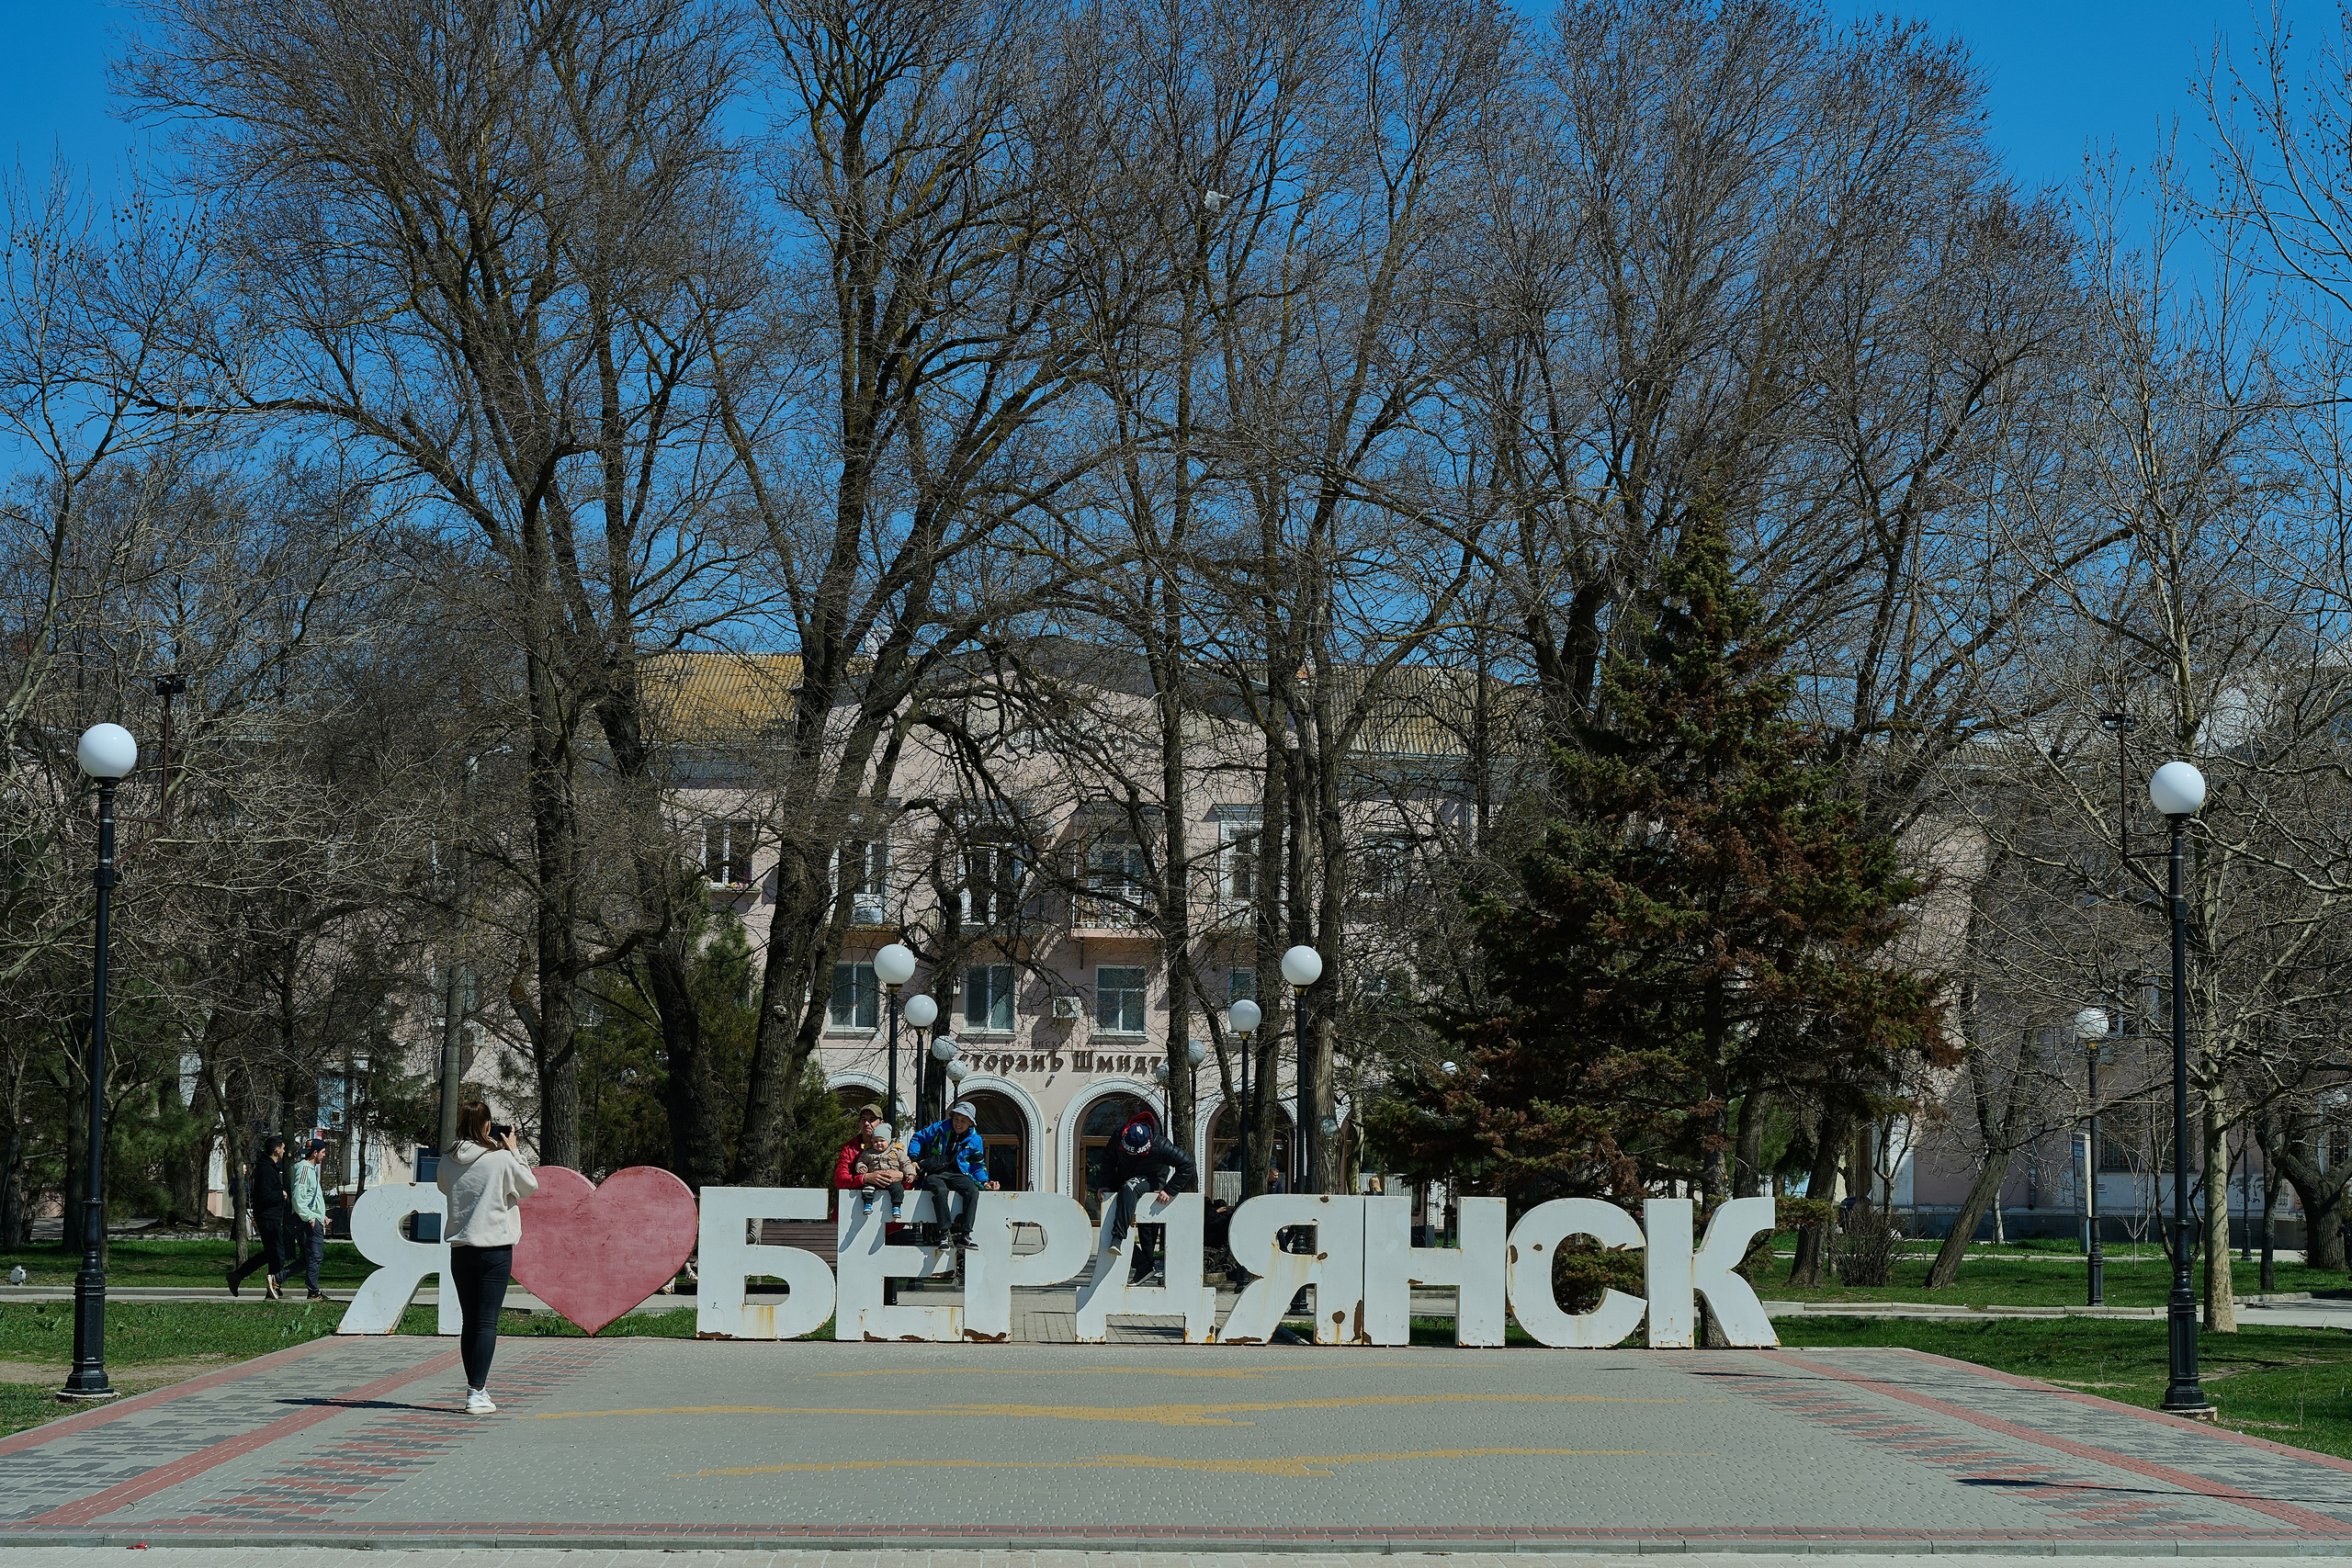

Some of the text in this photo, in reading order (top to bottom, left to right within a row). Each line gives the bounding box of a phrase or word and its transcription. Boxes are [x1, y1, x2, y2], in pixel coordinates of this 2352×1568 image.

[1072, 1050, 1168, 1077] Шмидт
[335, 1181, 1781, 1349] Я БЕРДЯНСК
